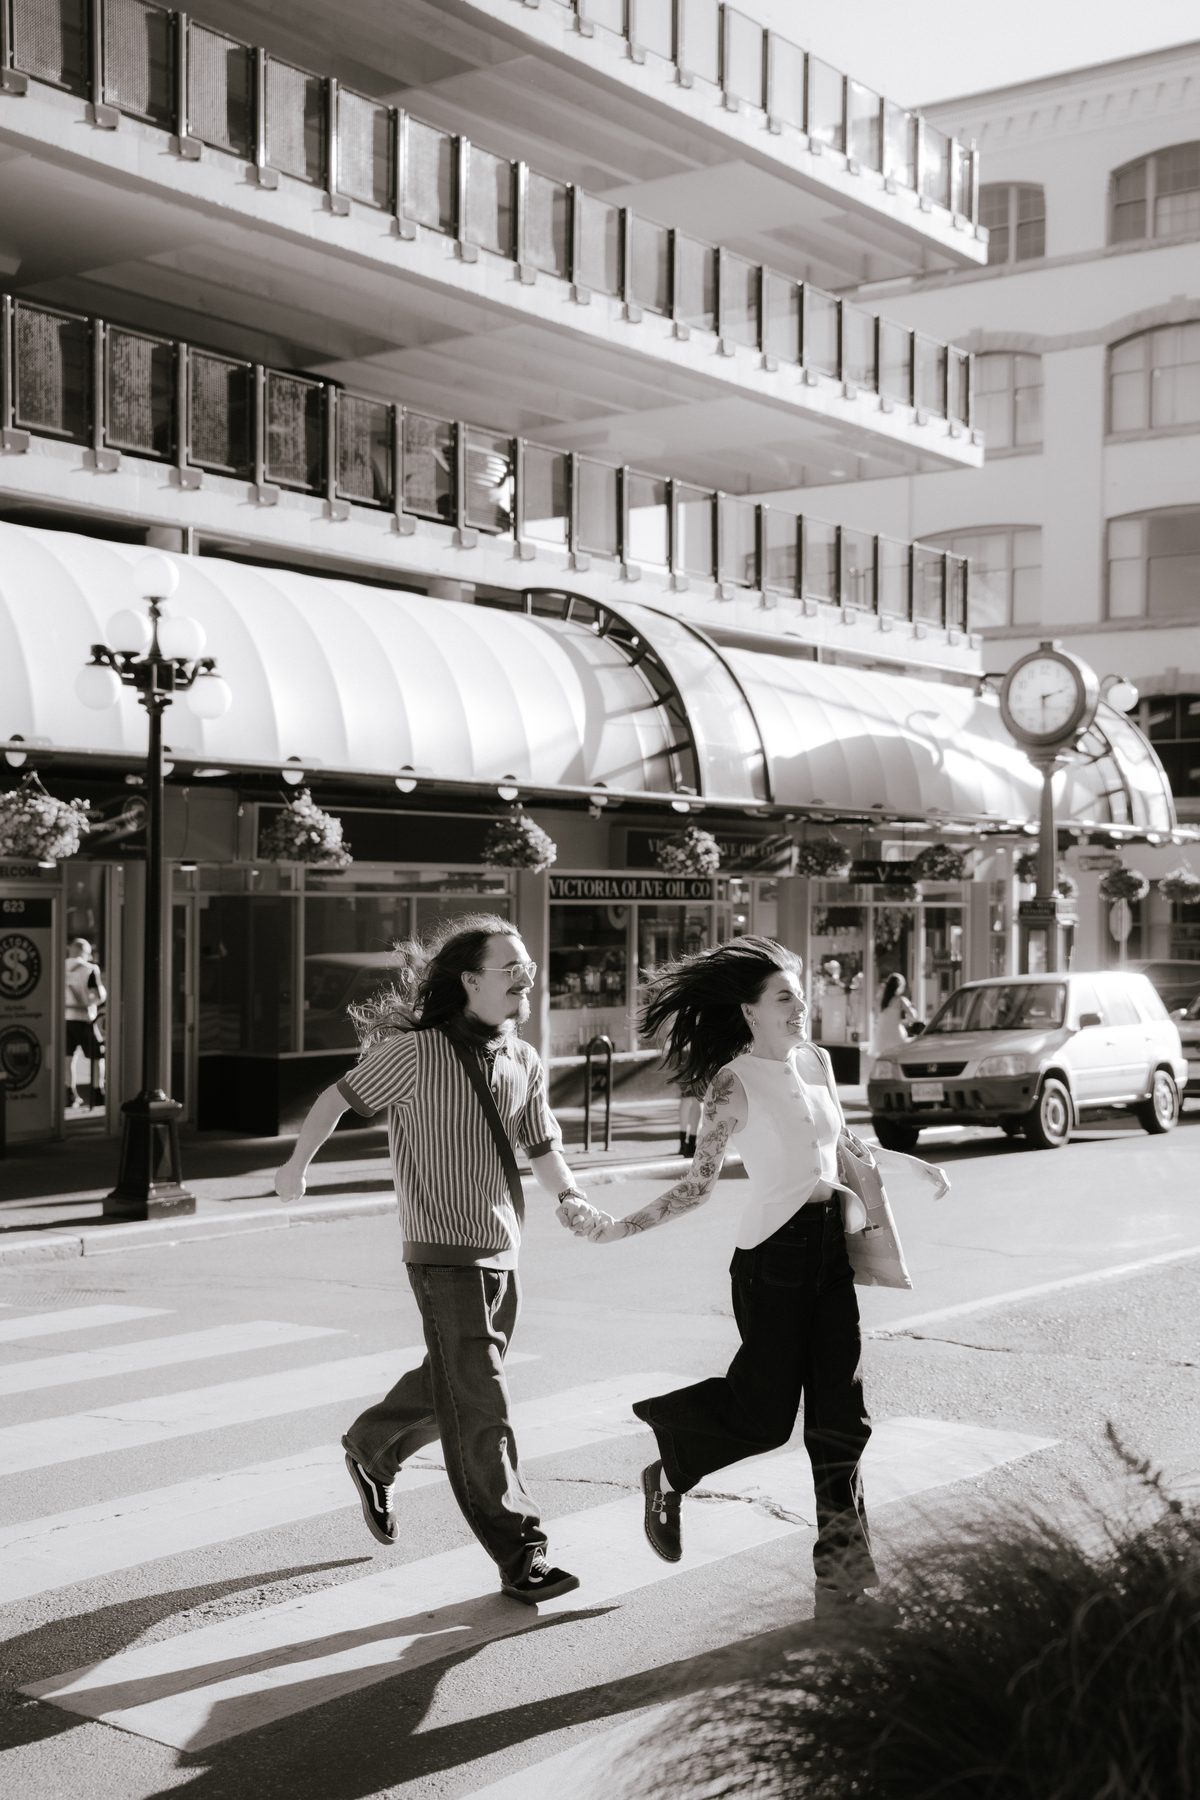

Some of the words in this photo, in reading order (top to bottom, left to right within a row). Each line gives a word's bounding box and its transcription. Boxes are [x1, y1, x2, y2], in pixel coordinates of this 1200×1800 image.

[0, 866, 41, 877] ELCOME
[550, 879, 619, 897] VICTORIA
[622, 880, 664, 897] OLIVE
[665, 881, 689, 897] OIL
[3, 900, 25, 912] 623
[0, 937, 37, 958] ICTORIA
